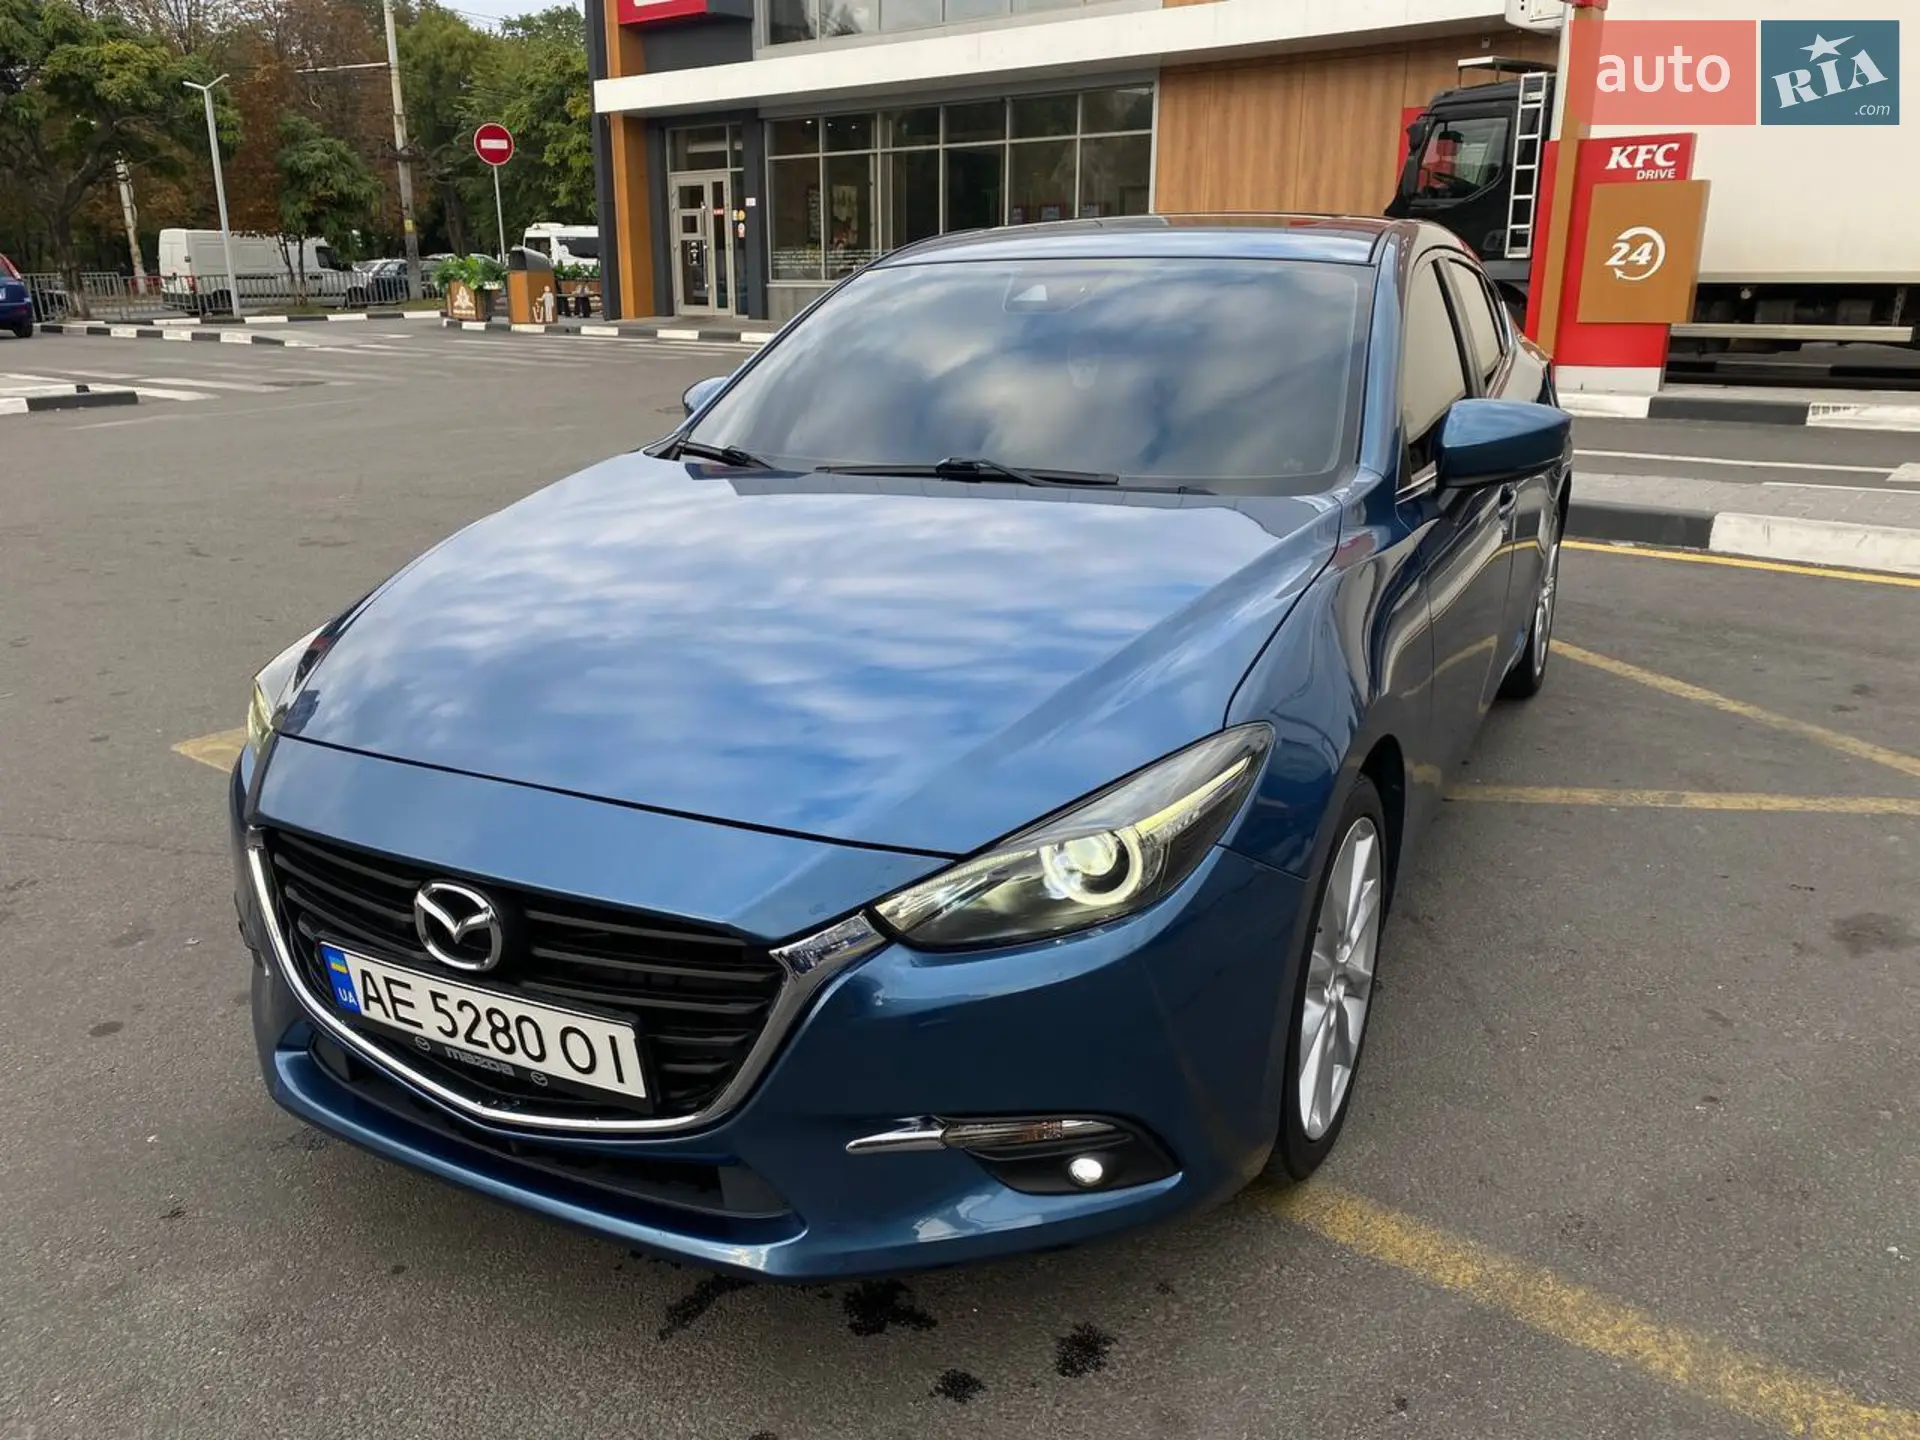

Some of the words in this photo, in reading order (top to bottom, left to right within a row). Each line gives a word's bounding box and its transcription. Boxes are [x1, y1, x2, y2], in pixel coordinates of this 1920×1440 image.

[1604, 142, 1681, 170] KFC
[1636, 168, 1677, 180] DRIVE
[1603, 241, 1655, 266] 24
[338, 986, 357, 1006] UA
[359, 968, 423, 1030] AE
[429, 989, 547, 1063] 5280
[559, 1025, 625, 1084] OI
